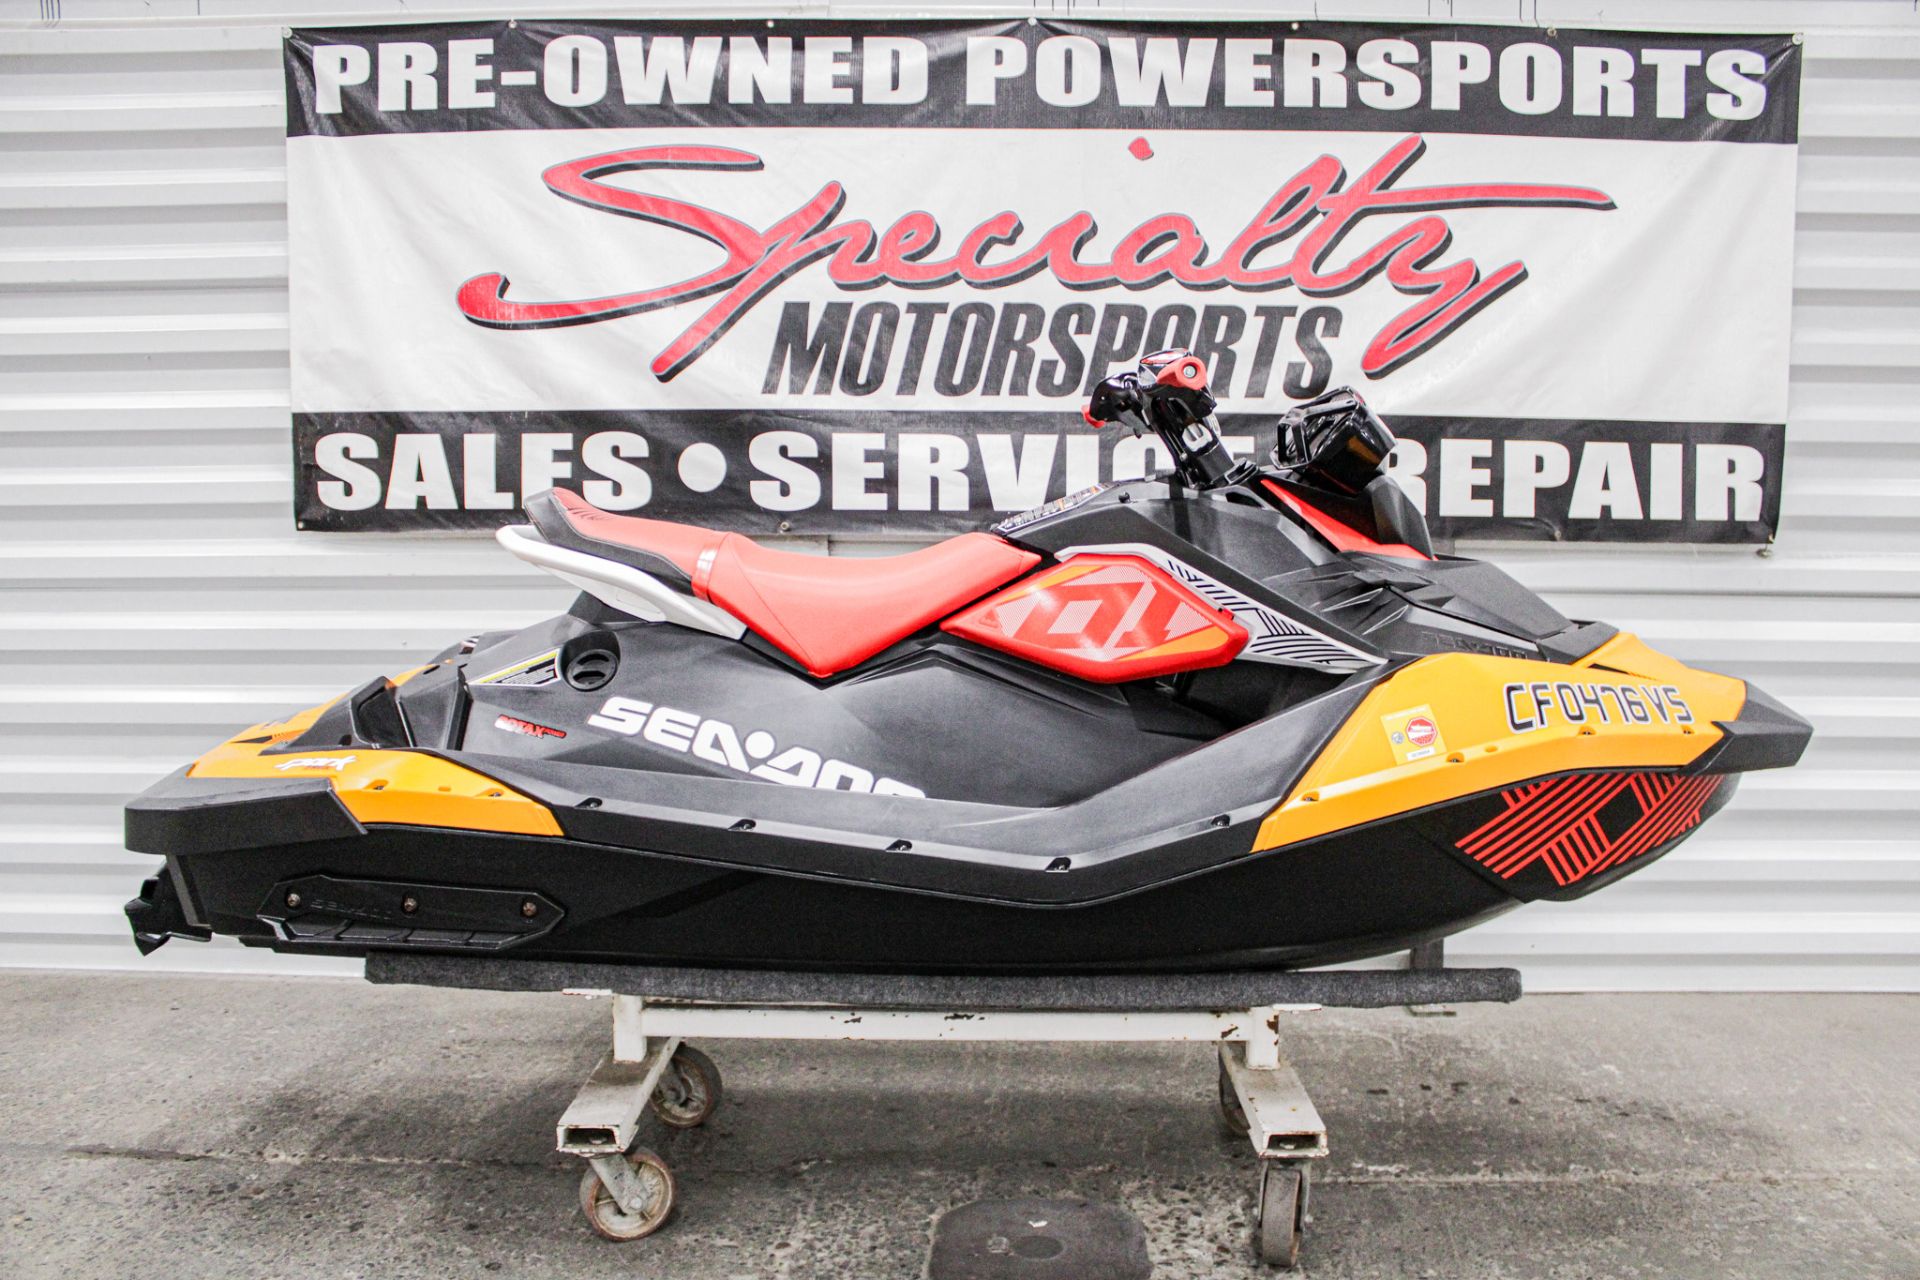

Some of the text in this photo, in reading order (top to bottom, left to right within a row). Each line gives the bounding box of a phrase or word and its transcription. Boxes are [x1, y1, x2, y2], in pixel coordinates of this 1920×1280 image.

[312, 35, 1767, 121] PRE-OWNED POWERSPORTS
[457, 133, 1617, 382] Specialty
[762, 301, 1342, 399] MOTORSPORTS
[315, 431, 651, 511] SALES
